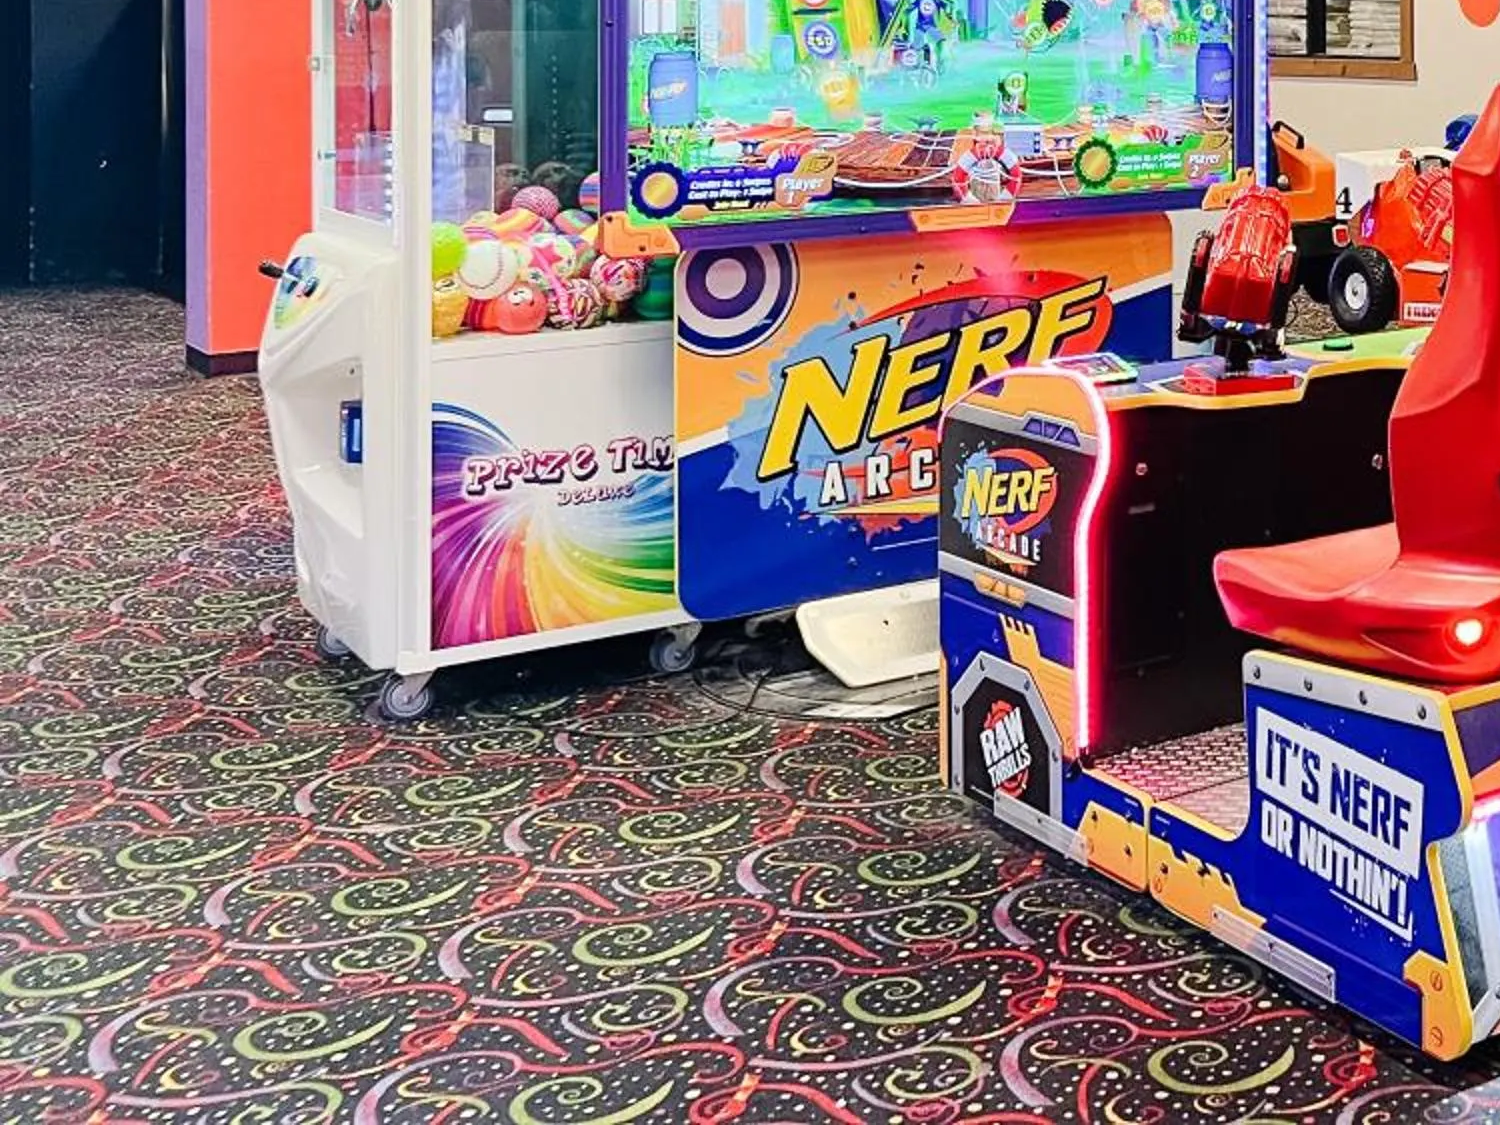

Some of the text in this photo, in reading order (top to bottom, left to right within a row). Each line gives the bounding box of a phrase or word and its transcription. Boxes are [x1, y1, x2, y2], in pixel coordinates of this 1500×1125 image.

[783, 177, 824, 191] Player
[1336, 187, 1353, 214] 4
[756, 277, 1108, 481] NERF
[820, 446, 940, 507] ARC
[961, 466, 1056, 519] NERF
[980, 706, 1025, 768] RAW
[988, 742, 1032, 789] THRILLS
[1265, 728, 1412, 851] IT'S NERF
[1261, 799, 1294, 859] OR
